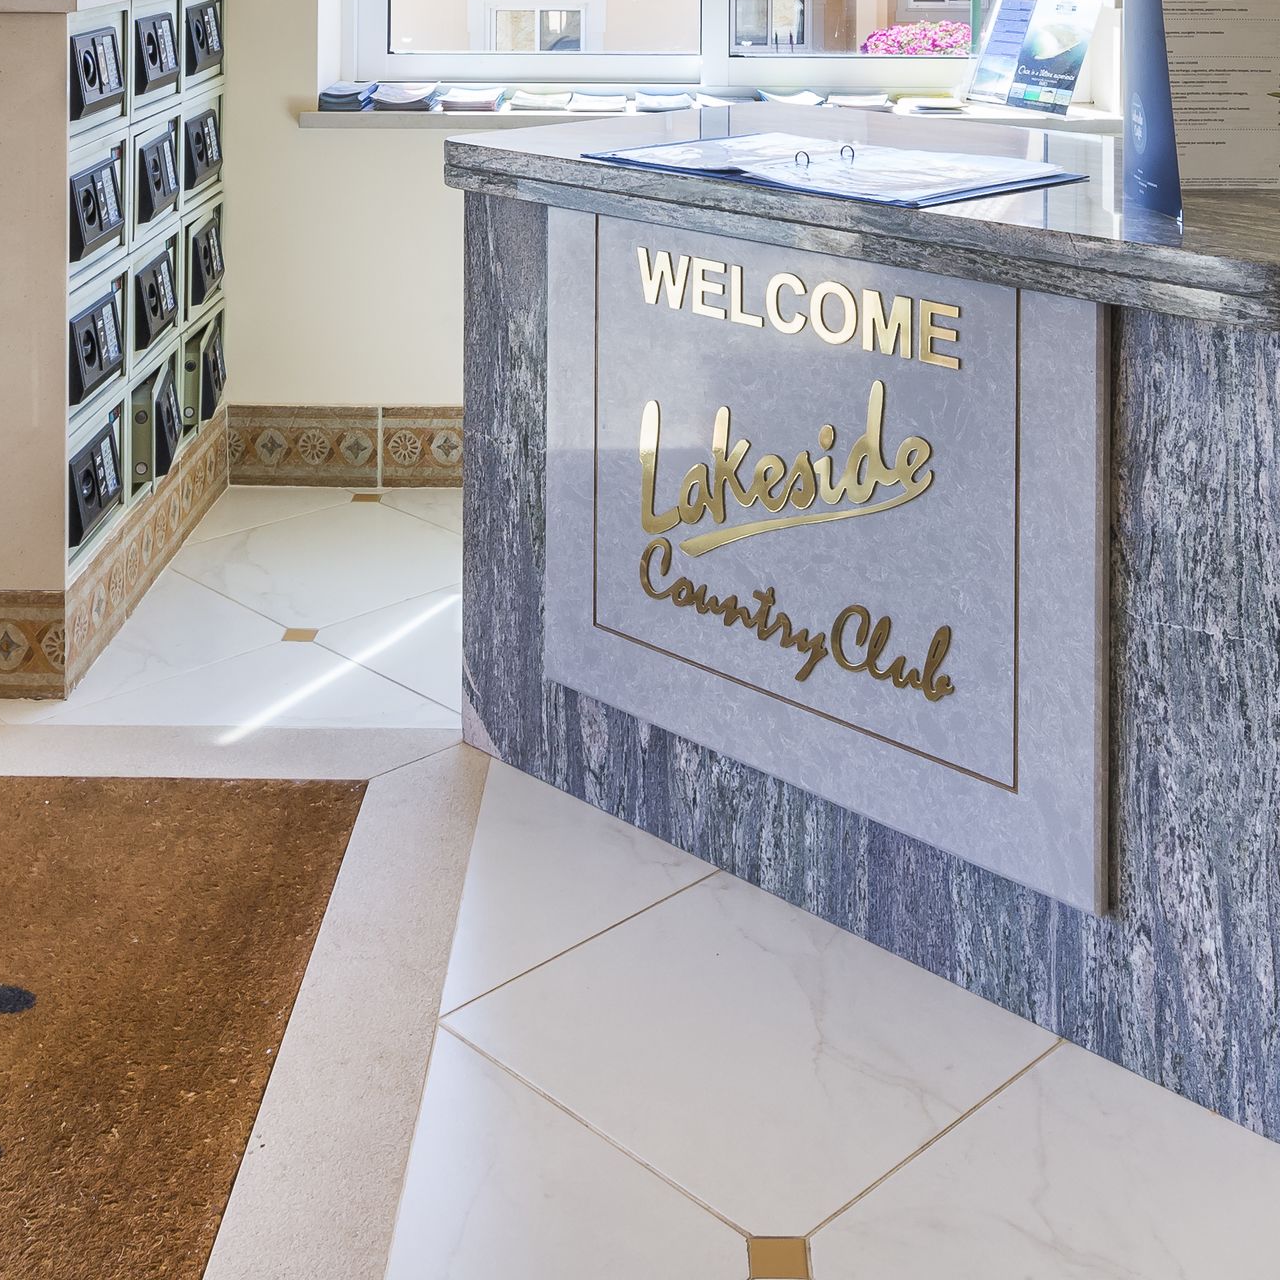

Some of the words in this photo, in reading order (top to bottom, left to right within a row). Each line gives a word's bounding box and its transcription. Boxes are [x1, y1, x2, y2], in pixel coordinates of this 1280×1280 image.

[636, 246, 963, 371] WELCOME
[638, 378, 936, 557] Lakeside
[638, 536, 829, 683] Country
[829, 603, 955, 703] Club
